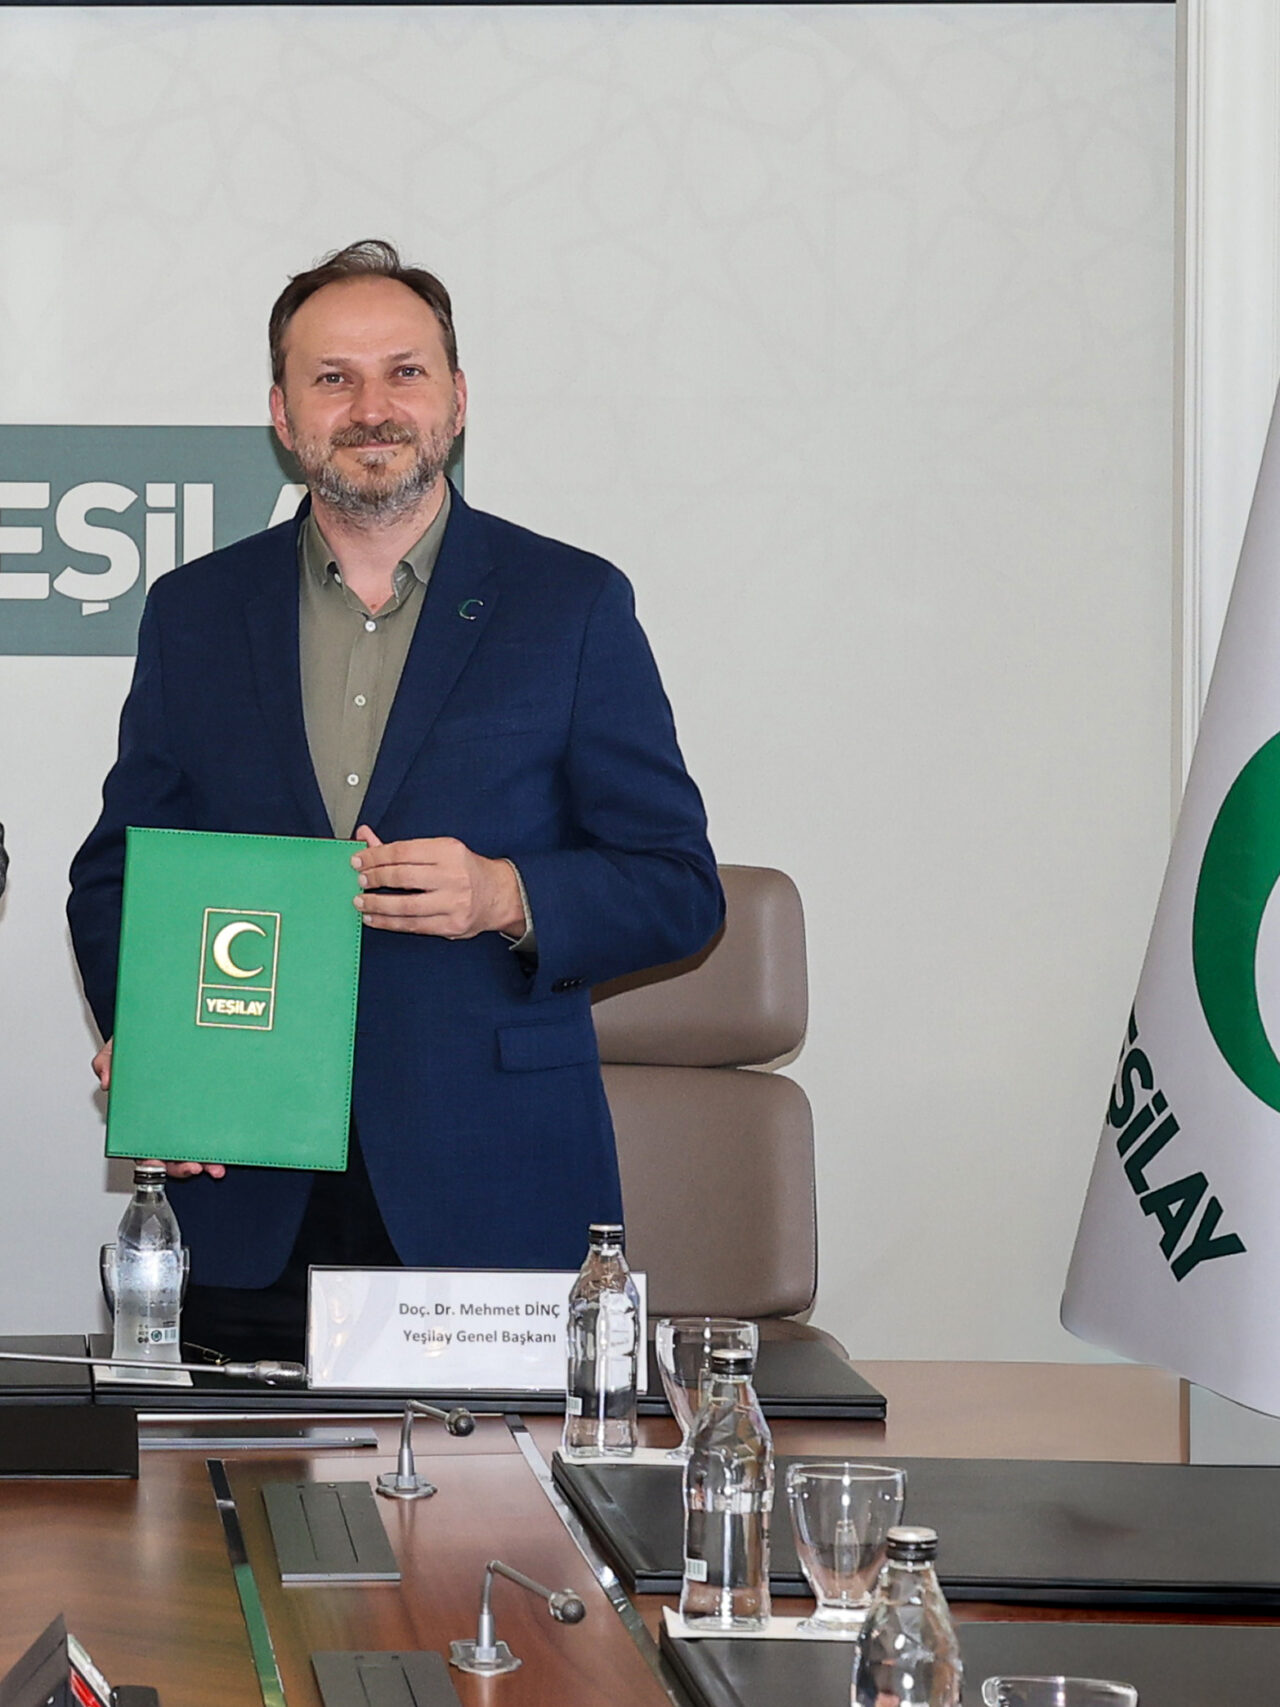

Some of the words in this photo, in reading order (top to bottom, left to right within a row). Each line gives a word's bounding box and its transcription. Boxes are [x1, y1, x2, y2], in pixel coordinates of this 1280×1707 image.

[399, 1302, 430, 1318] Doç.
[434, 1303, 456, 1316] Dr.
[460, 1303, 520, 1316] Mehmet
[525, 1301, 560, 1320] DİNÇ
[403, 1329, 452, 1345] Yeşilay
[456, 1330, 497, 1343] Genel
[502, 1330, 556, 1345] Başkanı
